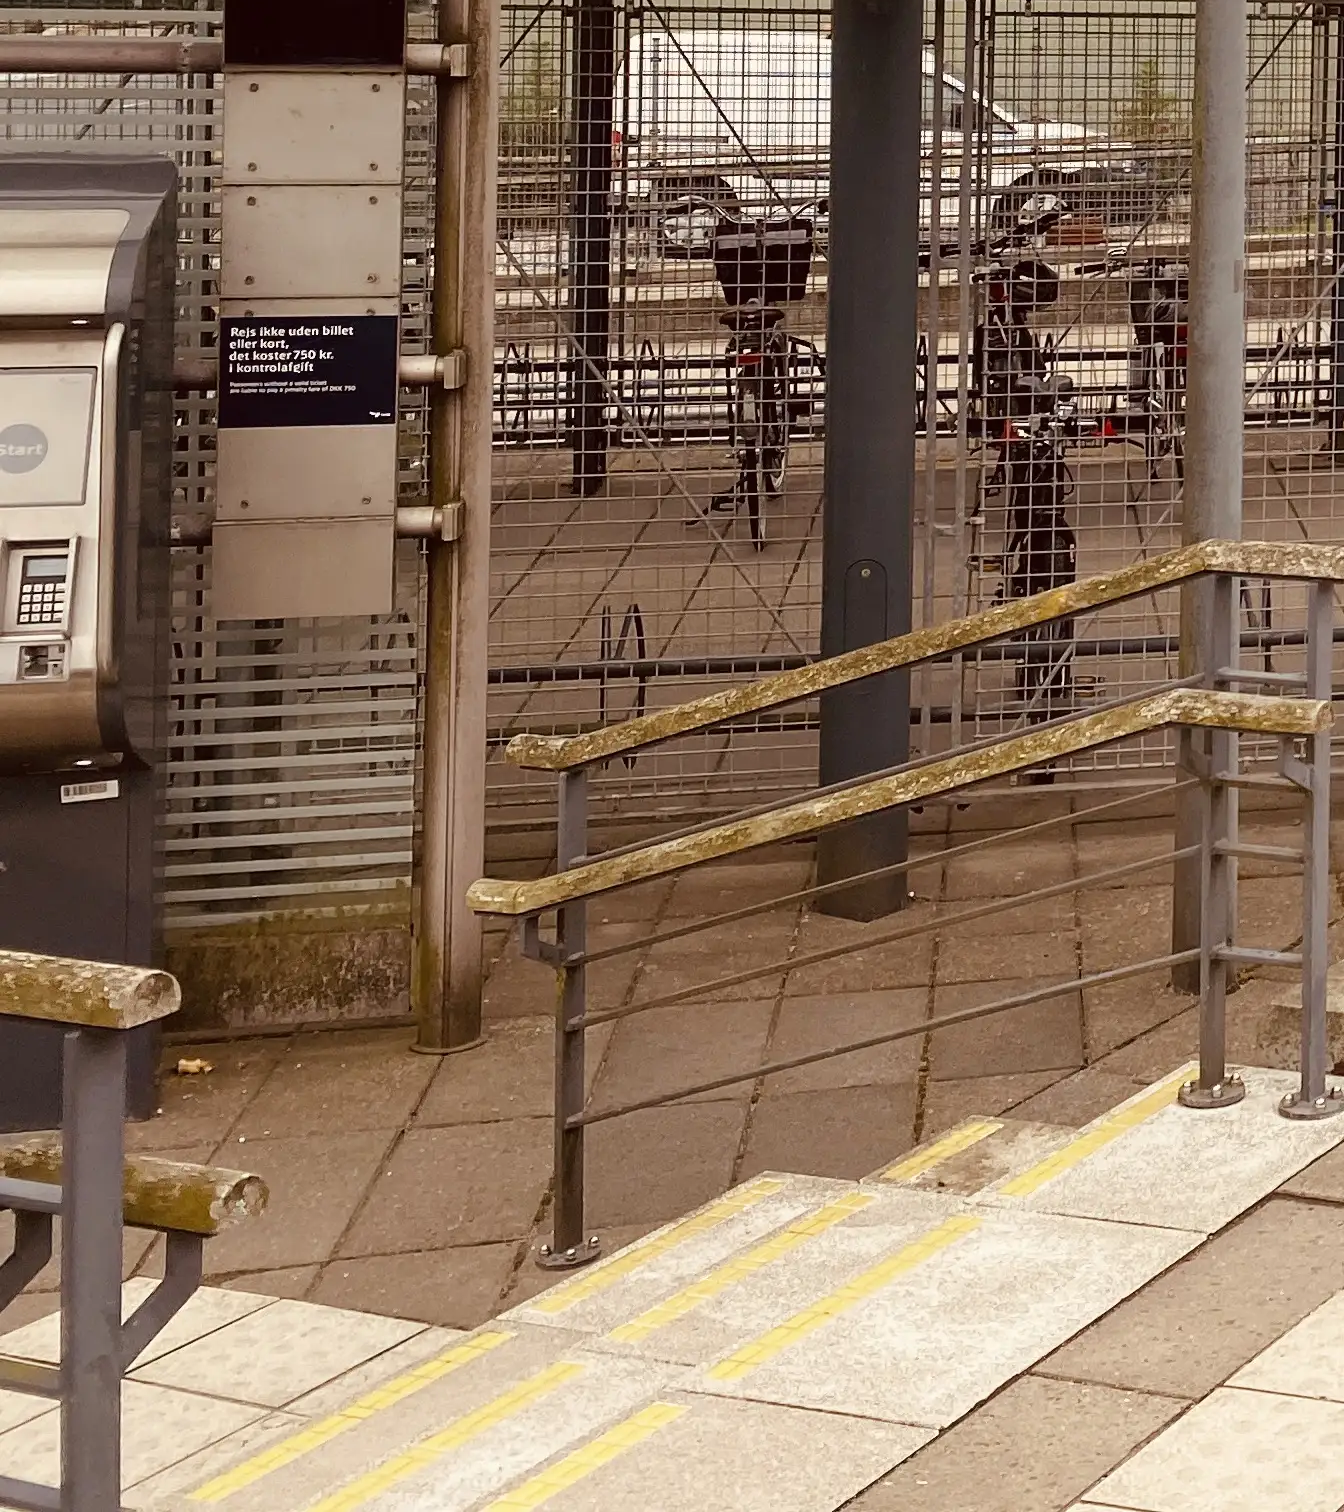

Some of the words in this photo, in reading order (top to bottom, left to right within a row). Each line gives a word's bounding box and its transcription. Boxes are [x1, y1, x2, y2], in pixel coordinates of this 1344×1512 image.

[230, 327, 257, 339] Rejs
[259, 326, 286, 337] ikke
[288, 326, 319, 336] uden
[322, 325, 354, 336] billet
[229, 339, 258, 349] eller
[260, 338, 290, 350] kort,
[229, 351, 250, 361] det
[252, 350, 293, 361] koster
[293, 350, 316, 360] 750
[319, 350, 334, 360] kr.
[229, 362, 233, 373] i
[236, 361, 314, 374] kontrolafgift
